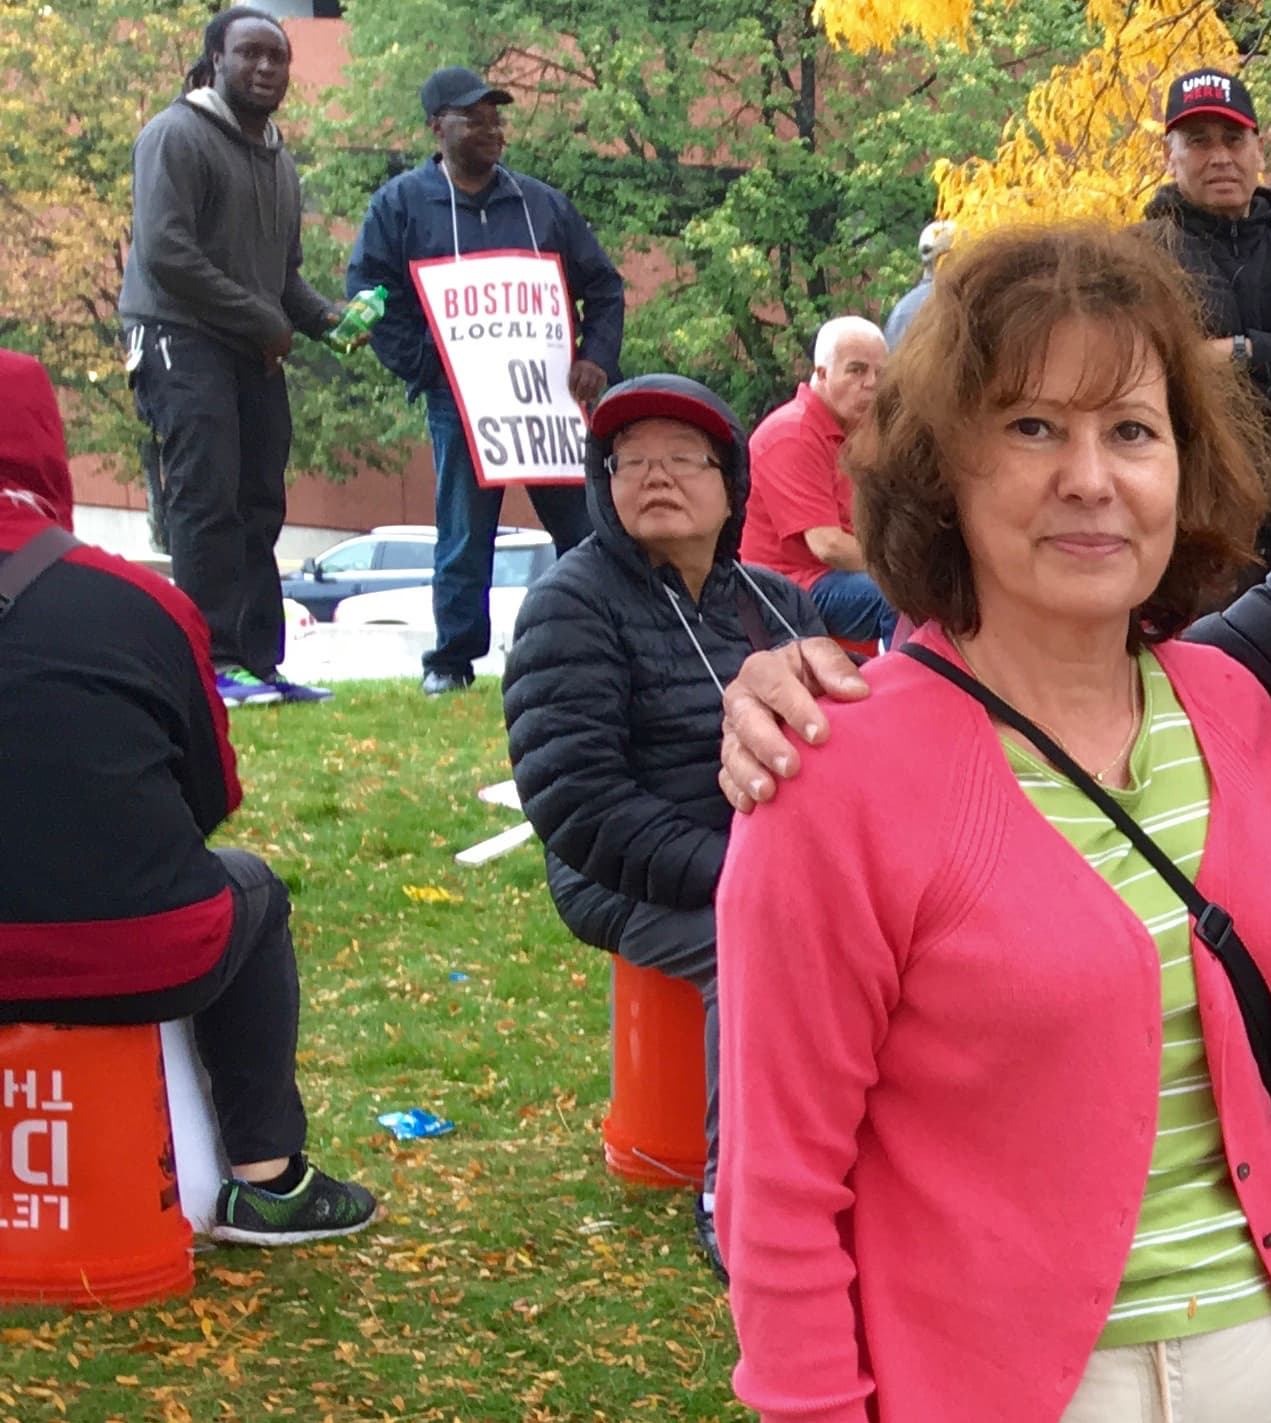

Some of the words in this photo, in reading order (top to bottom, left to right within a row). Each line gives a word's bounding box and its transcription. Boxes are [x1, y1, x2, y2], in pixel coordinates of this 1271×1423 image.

[1182, 75, 1231, 92] UNITE
[444, 281, 560, 319] BOSTON'S
[450, 321, 537, 341] LOCAL
[545, 323, 563, 341] 26
[508, 359, 552, 404] ON
[477, 415, 586, 466] STRIKE
